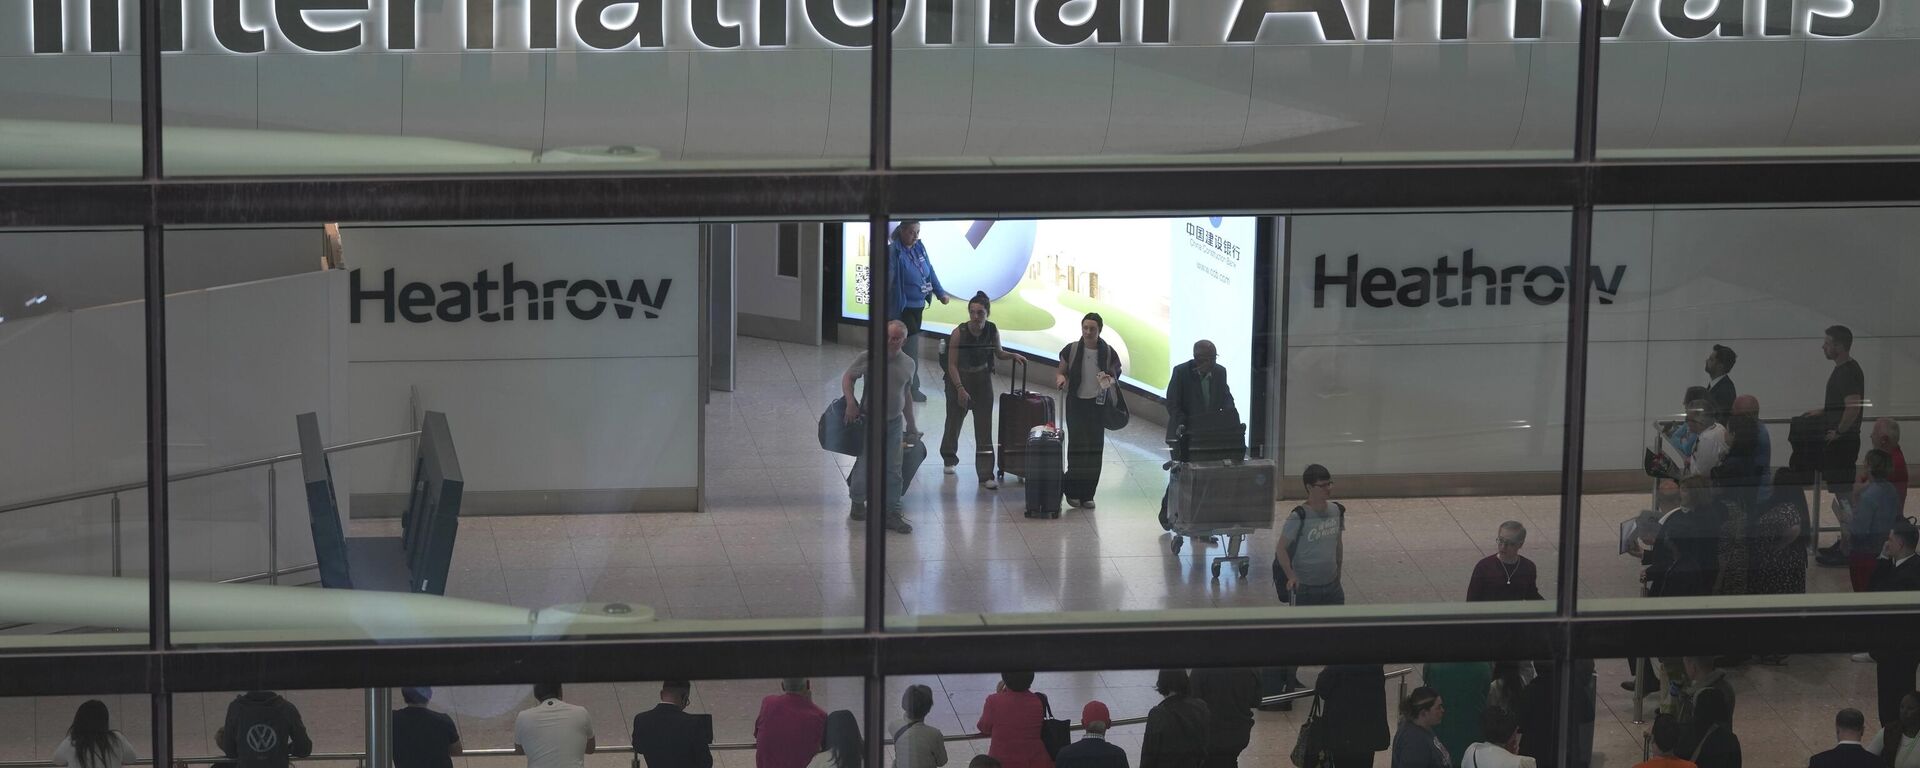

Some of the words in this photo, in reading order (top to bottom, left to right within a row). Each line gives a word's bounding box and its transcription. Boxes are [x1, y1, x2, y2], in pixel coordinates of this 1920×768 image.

[1186, 222, 1240, 261] 中国建设银行
[350, 262, 672, 323] Heathrow
[1314, 248, 1627, 308] Heathrow
